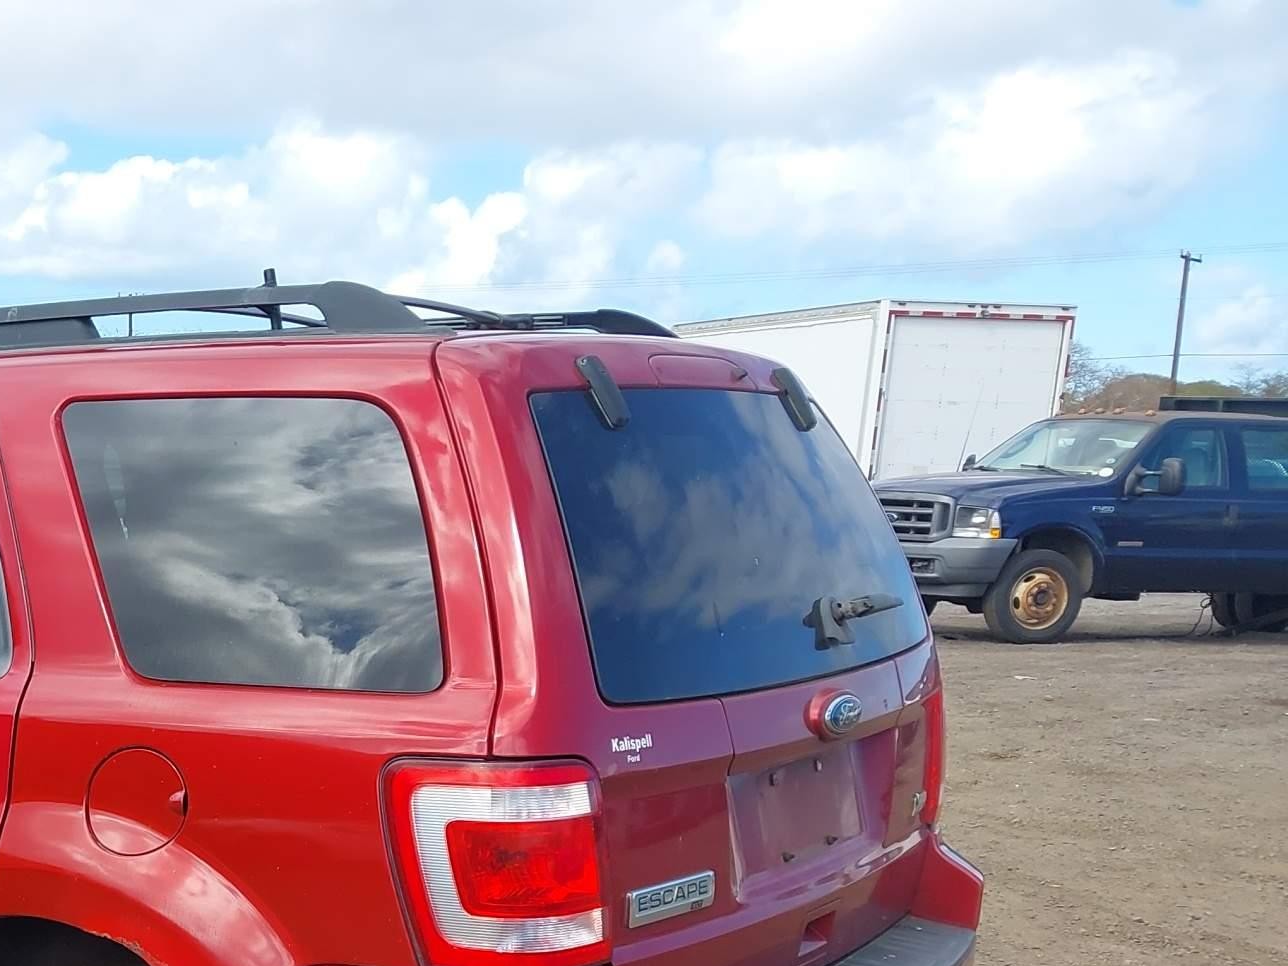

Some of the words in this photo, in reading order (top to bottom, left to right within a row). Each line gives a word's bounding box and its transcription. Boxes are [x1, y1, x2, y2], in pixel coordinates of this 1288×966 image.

[611, 733, 653, 752] Kalispell
[627, 754, 641, 763] Ford
[638, 879, 709, 912] ESCAPE
